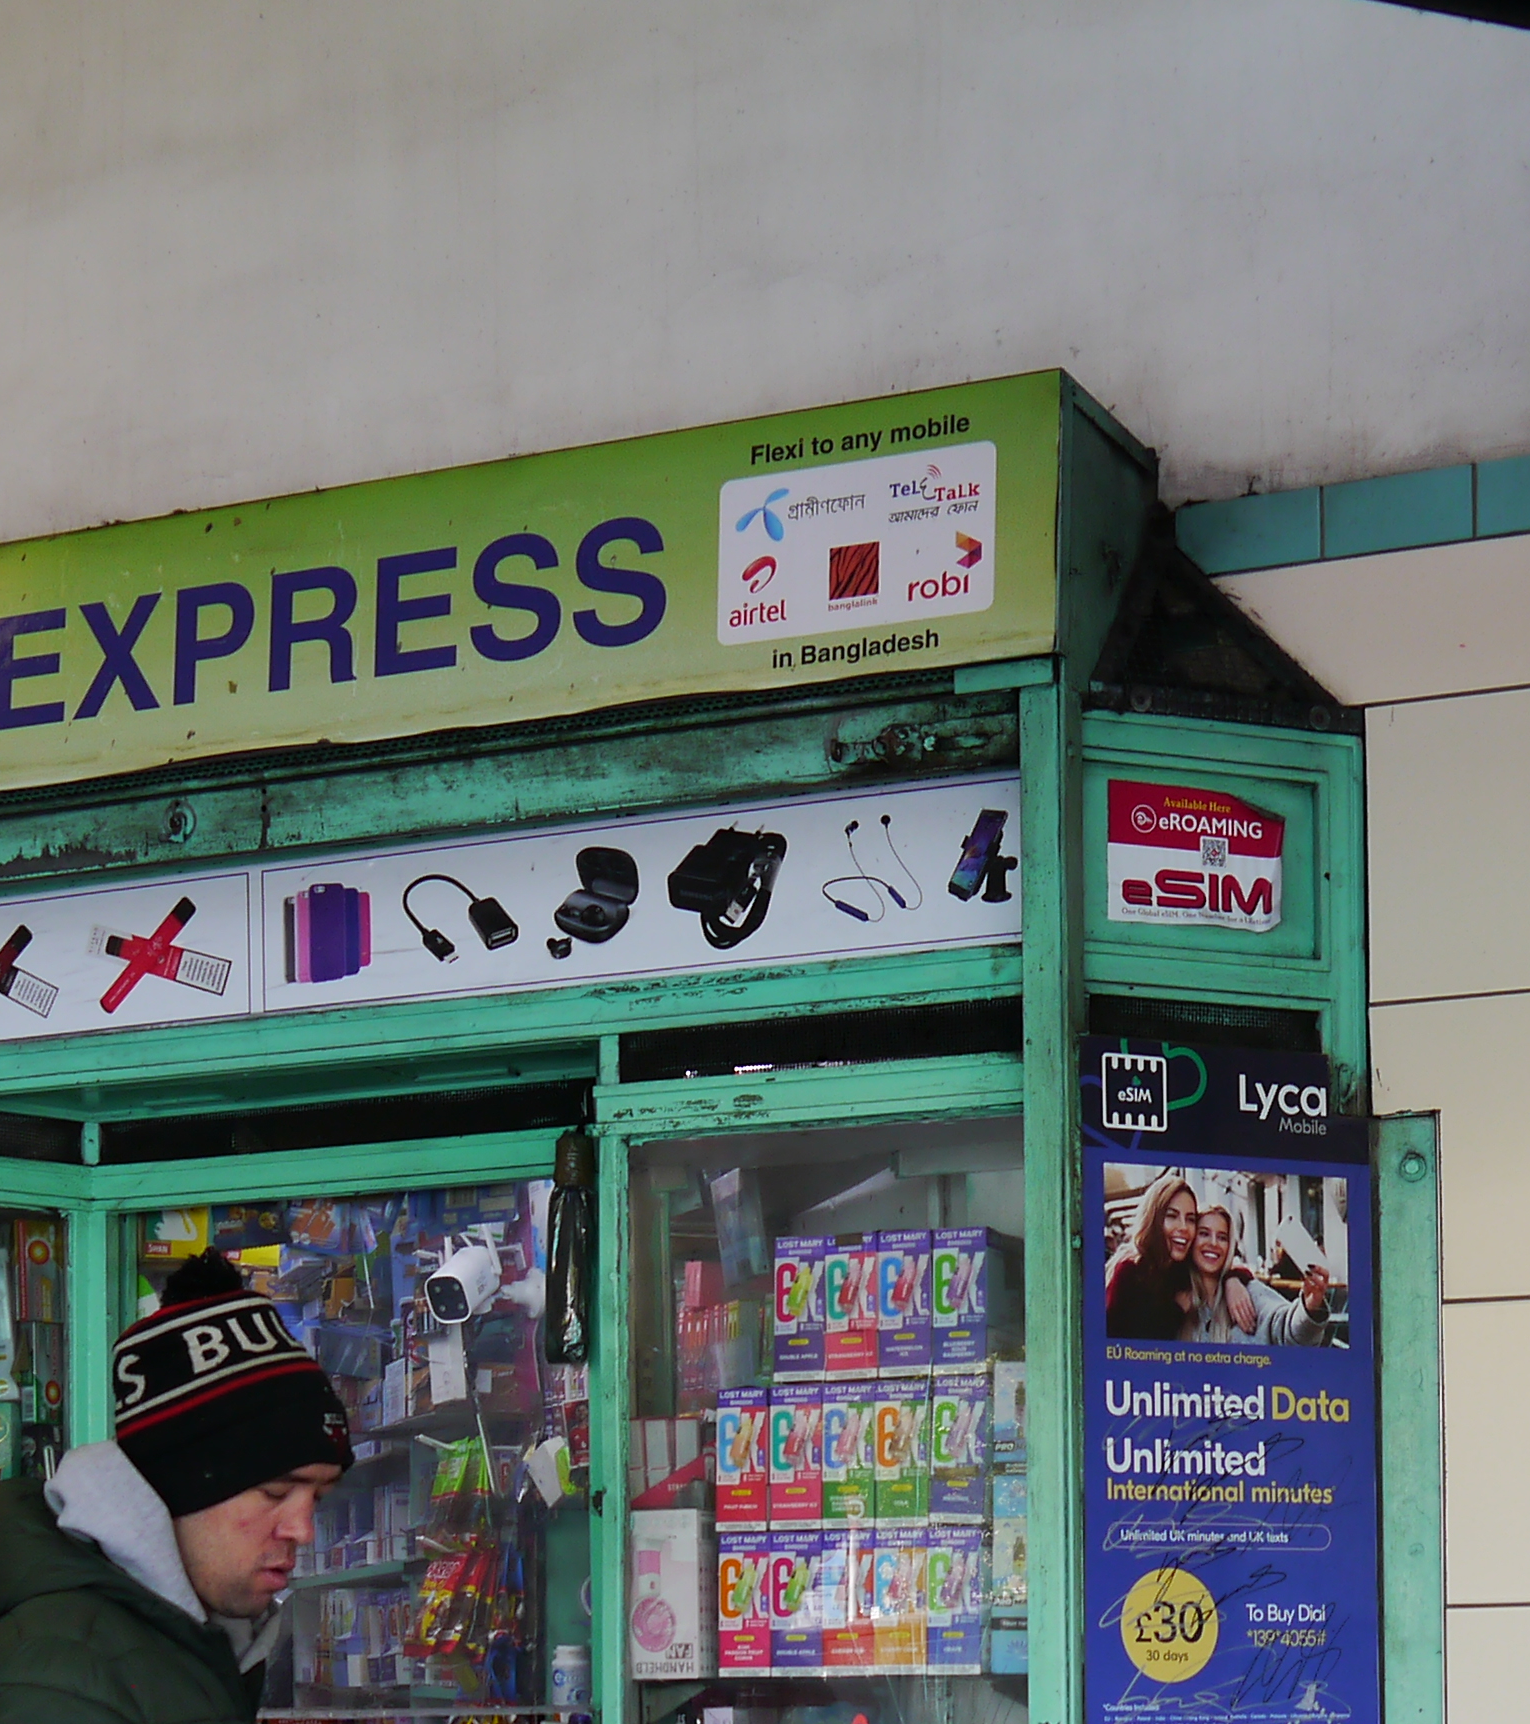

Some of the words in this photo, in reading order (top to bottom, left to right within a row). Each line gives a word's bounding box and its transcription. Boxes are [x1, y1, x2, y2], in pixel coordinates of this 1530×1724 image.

[750, 438, 804, 466] Flexi
[812, 436, 834, 456] to
[841, 431, 883, 453] any
[890, 414, 971, 444] mobile
[907, 570, 970, 602] robi
[729, 599, 787, 628] airtel
[827, 597, 879, 612] banglalink
[772, 648, 793, 669] in
[801, 629, 940, 666] Bangladesh
[1164, 796, 1208, 812] Available
[1209, 801, 1232, 814] Here
[1159, 813, 1263, 840] eROAMING
[1122, 868, 1273, 916] eSIM
[1118, 1087, 1153, 1104] eSIM
[1238, 1073, 1328, 1121] Lyca
[1278, 1117, 1328, 1136] Mobile
[777, 1240, 799, 1249] LOST
[801, 1239, 823, 1248] MARY
[880, 1234, 902, 1243] LOST
[903, 1232, 927, 1241] MARY
[935, 1231, 957, 1241] LOST
[959, 1229, 983, 1239] MARY
[1124, 1347, 1172, 1364] Roaming
[1174, 1351, 1186, 1363] at
[1188, 1353, 1203, 1363] no
[1205, 1352, 1232, 1364] extra
[719, 1391, 740, 1399] LOST
[741, 1390, 763, 1398] MARY
[773, 1389, 795, 1397] LOST
[797, 1387, 819, 1395] MARY
[825, 1386, 848, 1394] LOST
[849, 1385, 871, 1393] MARY
[1105, 1379, 1265, 1420] Unlimited
[1271, 1386, 1350, 1423] Data
[1106, 1437, 1266, 1476] Unlimited
[1107, 1477, 1244, 1503] International
[721, 1537, 743, 1545] LOST
[745, 1536, 766, 1544] MARY
[773, 1536, 795, 1544] LOST
[797, 1535, 820, 1543] MARY
[1135, 1600, 1205, 1644] £30
[1246, 1603, 1265, 1622] To
[1268, 1603, 1295, 1625] Buy
[1297, 1603, 1326, 1621] Dial
[1146, 1650, 1161, 1661] 30
[1163, 1650, 1189, 1663] days
